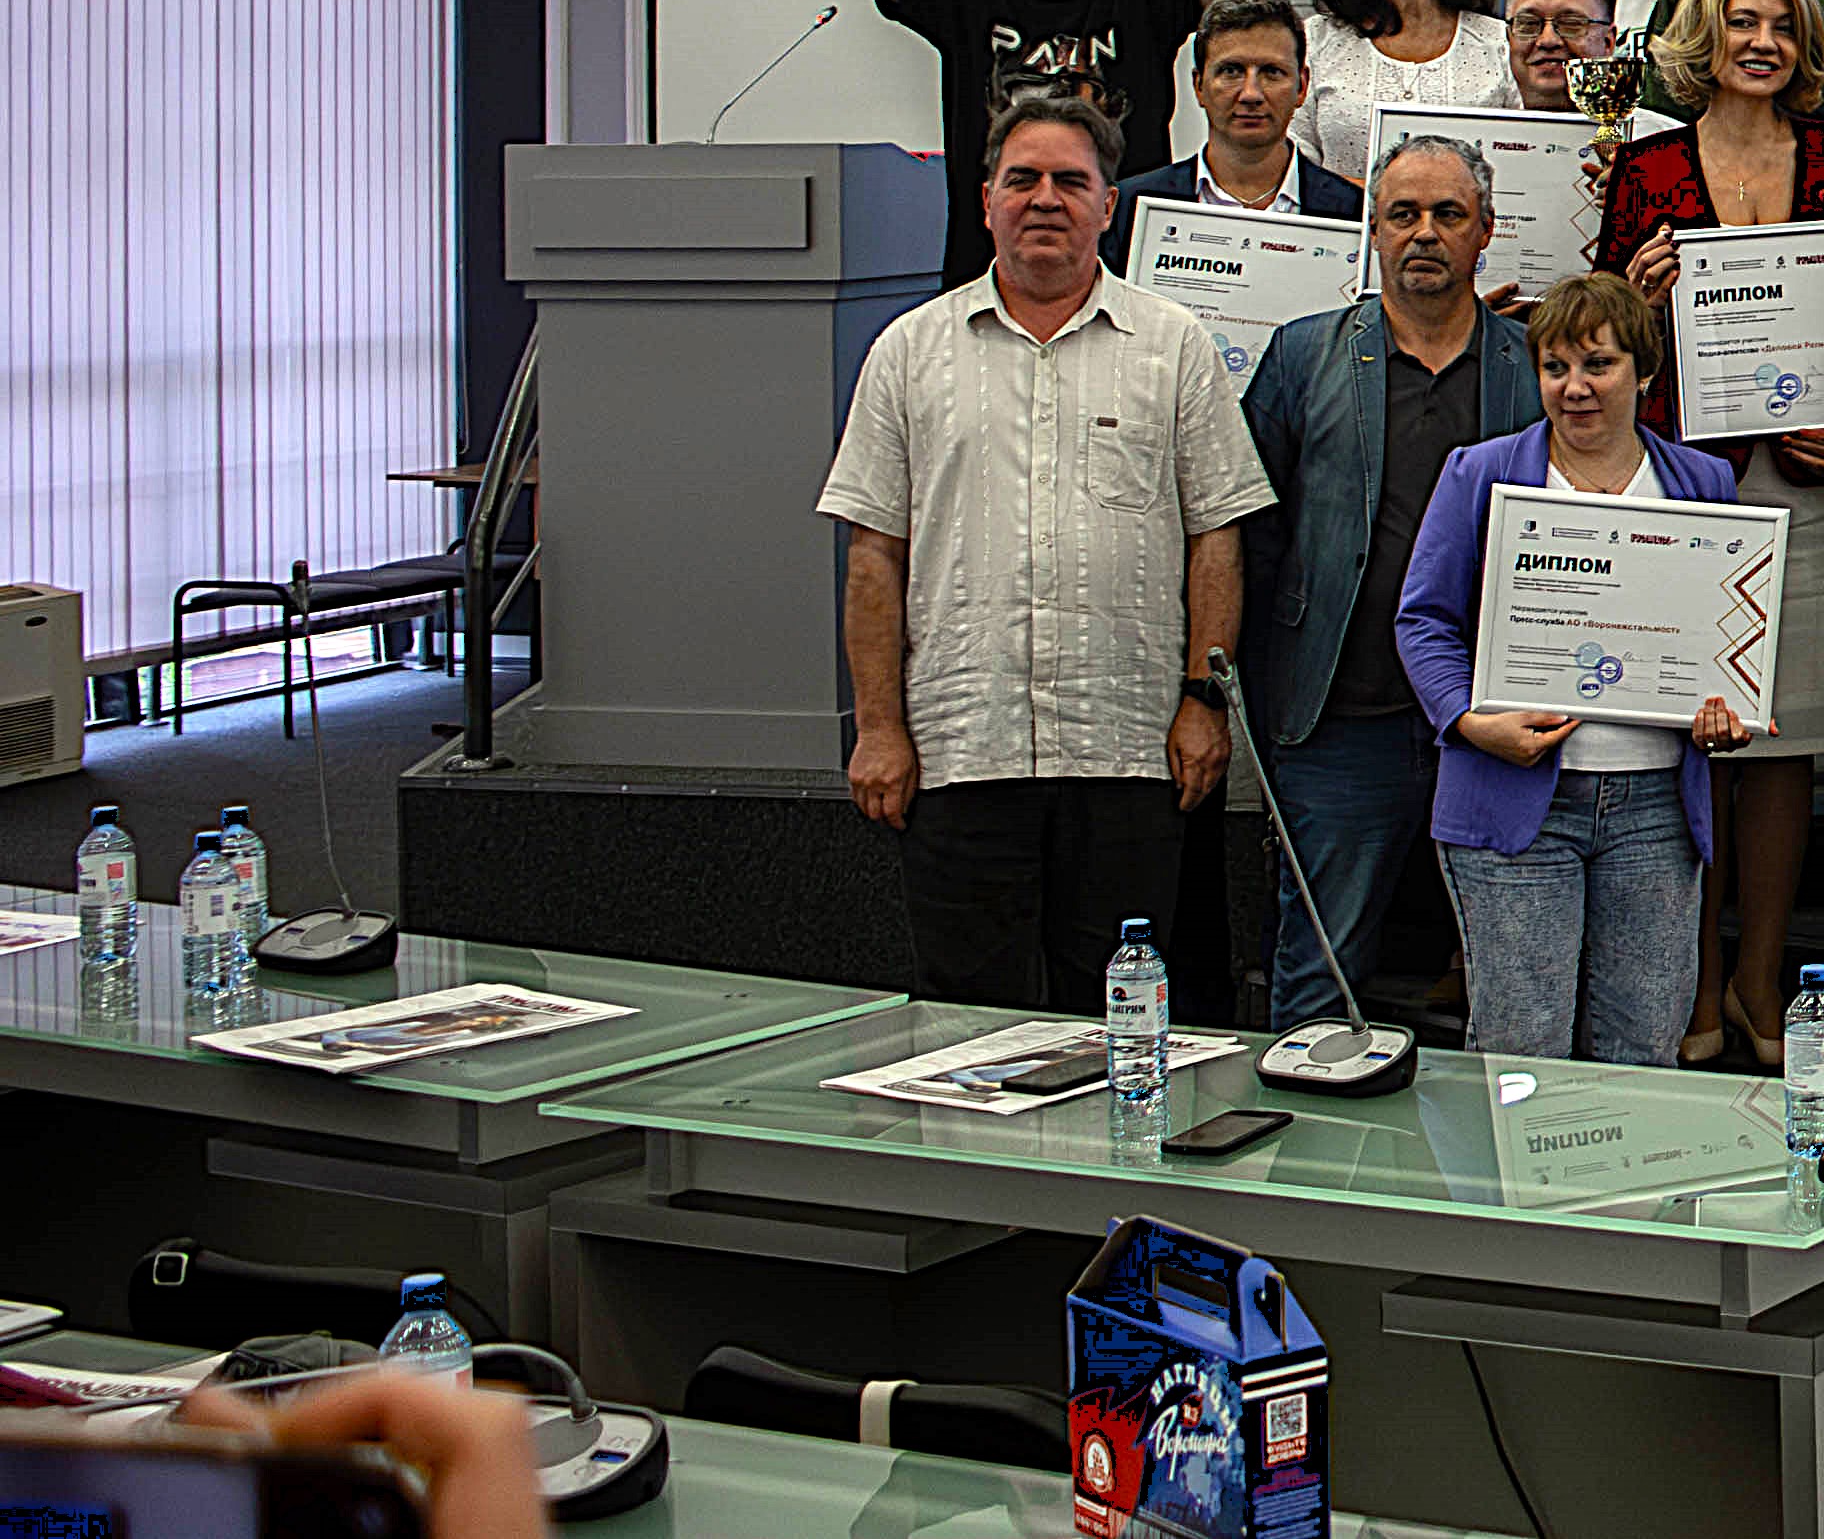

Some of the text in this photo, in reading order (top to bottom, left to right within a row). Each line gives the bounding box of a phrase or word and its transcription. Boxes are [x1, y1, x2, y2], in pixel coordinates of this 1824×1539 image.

[1156, 253, 1242, 276] ДИПЛОМ
[1694, 285, 1782, 307] ДИПЛОМ
[1515, 553, 1612, 575] ДИПЛОМ
